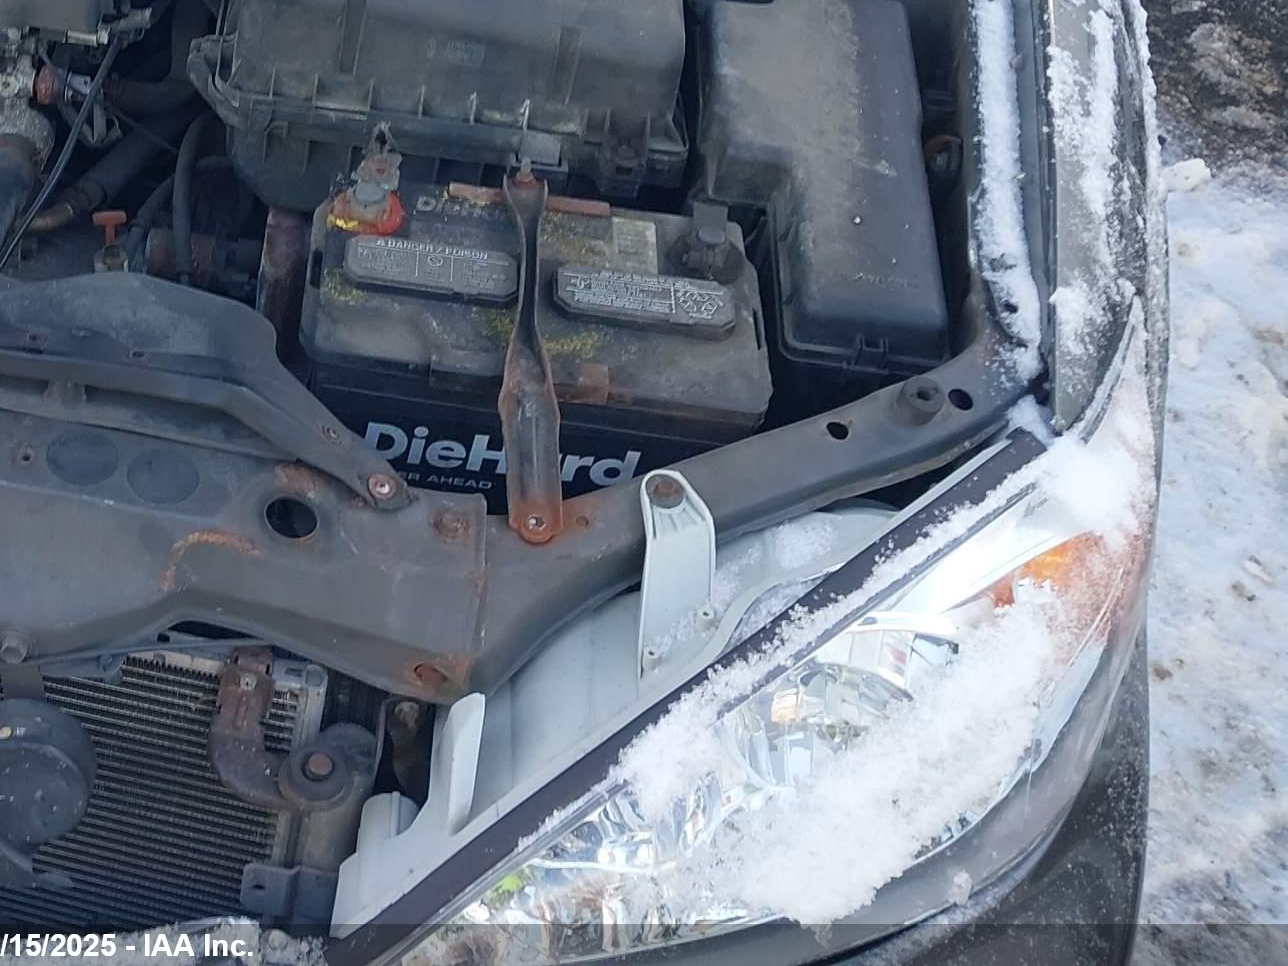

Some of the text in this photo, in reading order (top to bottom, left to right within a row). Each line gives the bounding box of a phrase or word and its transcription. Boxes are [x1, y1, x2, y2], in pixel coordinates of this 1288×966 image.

[444, 246, 489, 261] POISON
[364, 421, 642, 487] DieHrd
[427, 473, 493, 490] AHEAD
